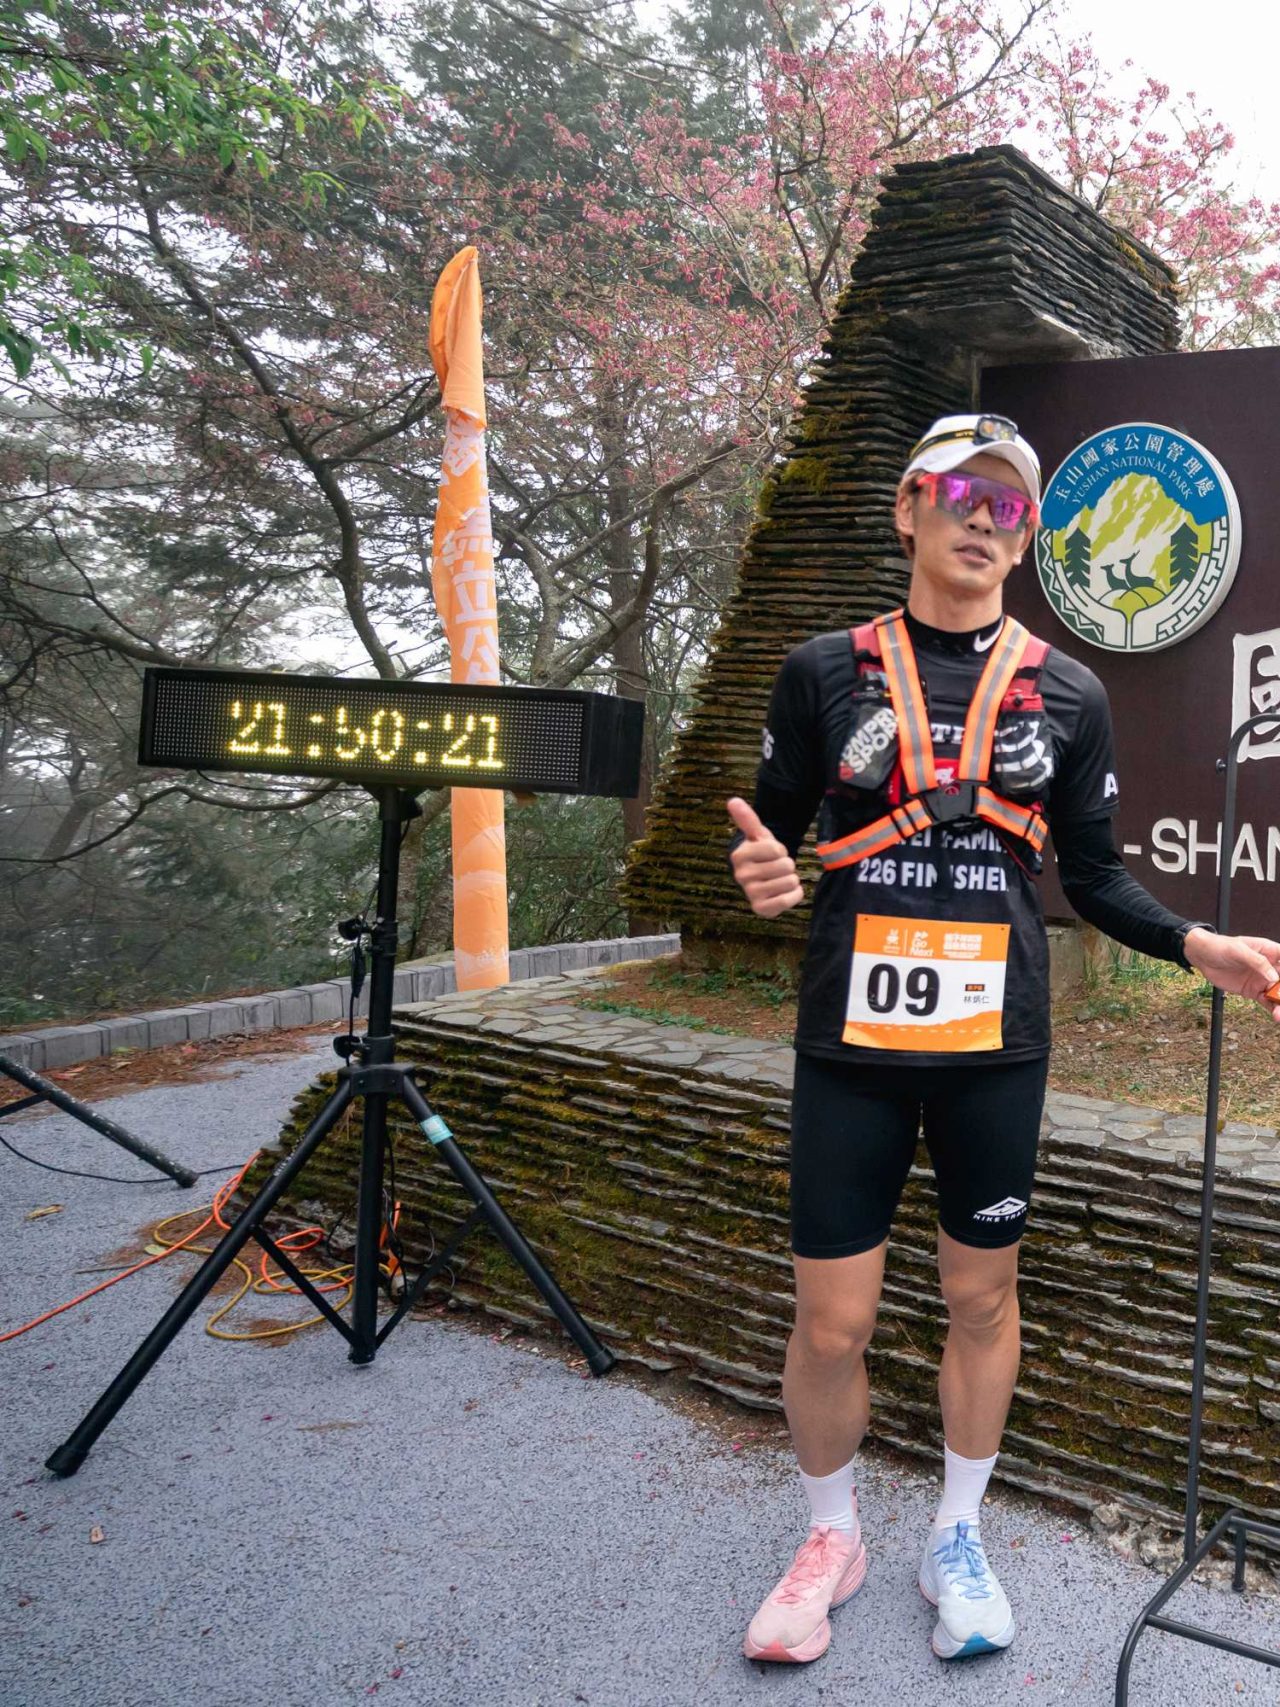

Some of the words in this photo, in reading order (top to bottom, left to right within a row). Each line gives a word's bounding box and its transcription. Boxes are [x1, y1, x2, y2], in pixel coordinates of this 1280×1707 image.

[1053, 432, 1216, 505] 玉山國家公園管理處
[1072, 463, 1111, 504] YUSHAN
[1111, 455, 1168, 475] NATIONAL
[1168, 469, 1194, 501] PARK
[857, 857, 897, 886] 226
[867, 963, 940, 1017] 09
[973, 1213, 1000, 1223] NIKE
